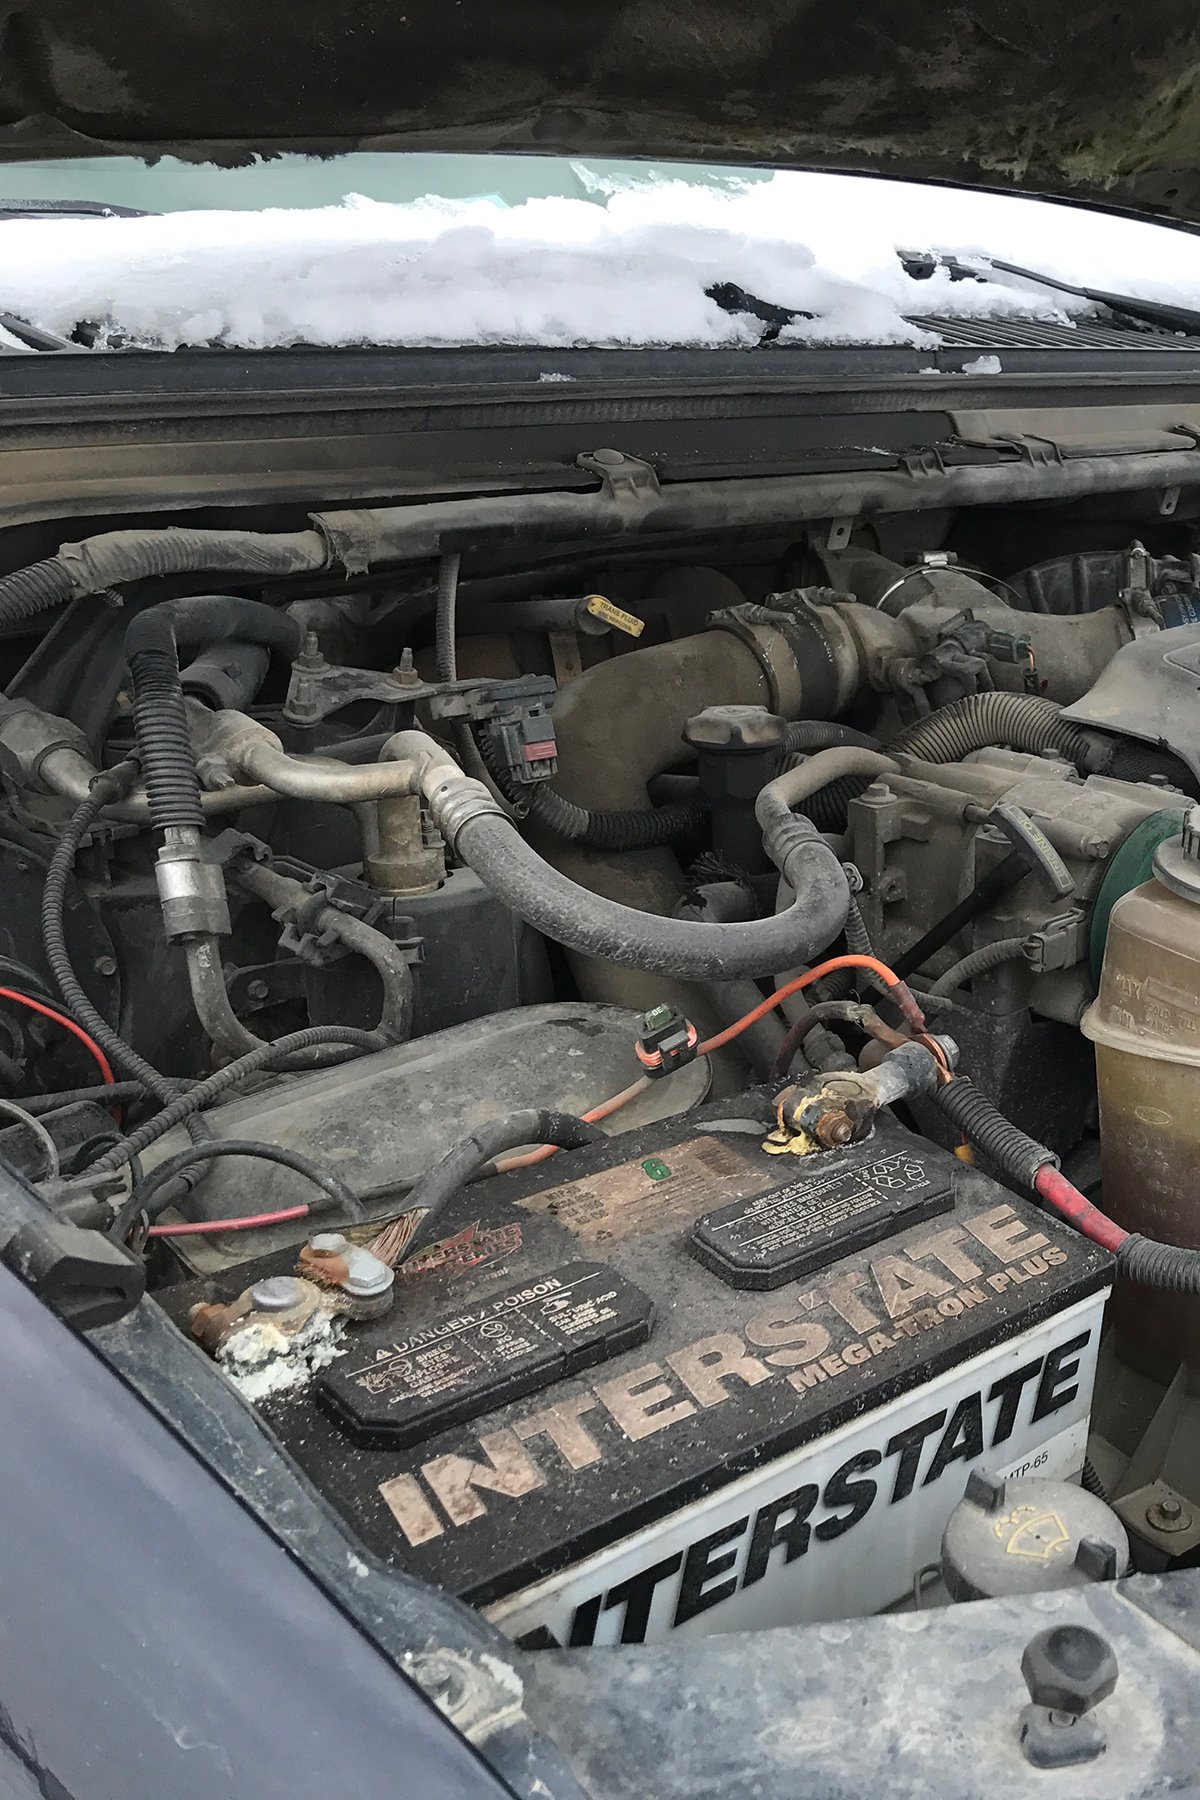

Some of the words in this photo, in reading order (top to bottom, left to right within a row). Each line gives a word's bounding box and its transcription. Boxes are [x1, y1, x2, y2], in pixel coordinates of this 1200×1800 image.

[600, 602, 620, 617] TRANS
[620, 613, 639, 626] FLUID
[1032, 828, 1066, 877] ENGINE
[630, 1156, 680, 1181] 6
[750, 1208, 778, 1223] FLUSH
[775, 1199, 797, 1212] EYES
[795, 1180, 844, 1204] IMMEDIATELY
[796, 1205, 817, 1217] HELP
[816, 1197, 837, 1208] FAST
[805, 1196, 822, 1206] GET
[593, 1290, 618, 1304] ACID
[392, 1311, 476, 1354] DANGER
[491, 1276, 563, 1313] POISON
[554, 1317, 571, 1327] CAN
[788, 1283, 985, 1394] MEGA-TRON
[989, 1246, 1069, 1311] PLUS
[495, 1334, 513, 1345] NO
[414, 1342, 453, 1362] SHIELD
[421, 1351, 450, 1368] EYES
[378, 1204, 1053, 1546] INTERSTATE
[402, 1354, 461, 1383] EXPLOSIVE
[515, 1329, 1093, 1649] NTERSTATE
